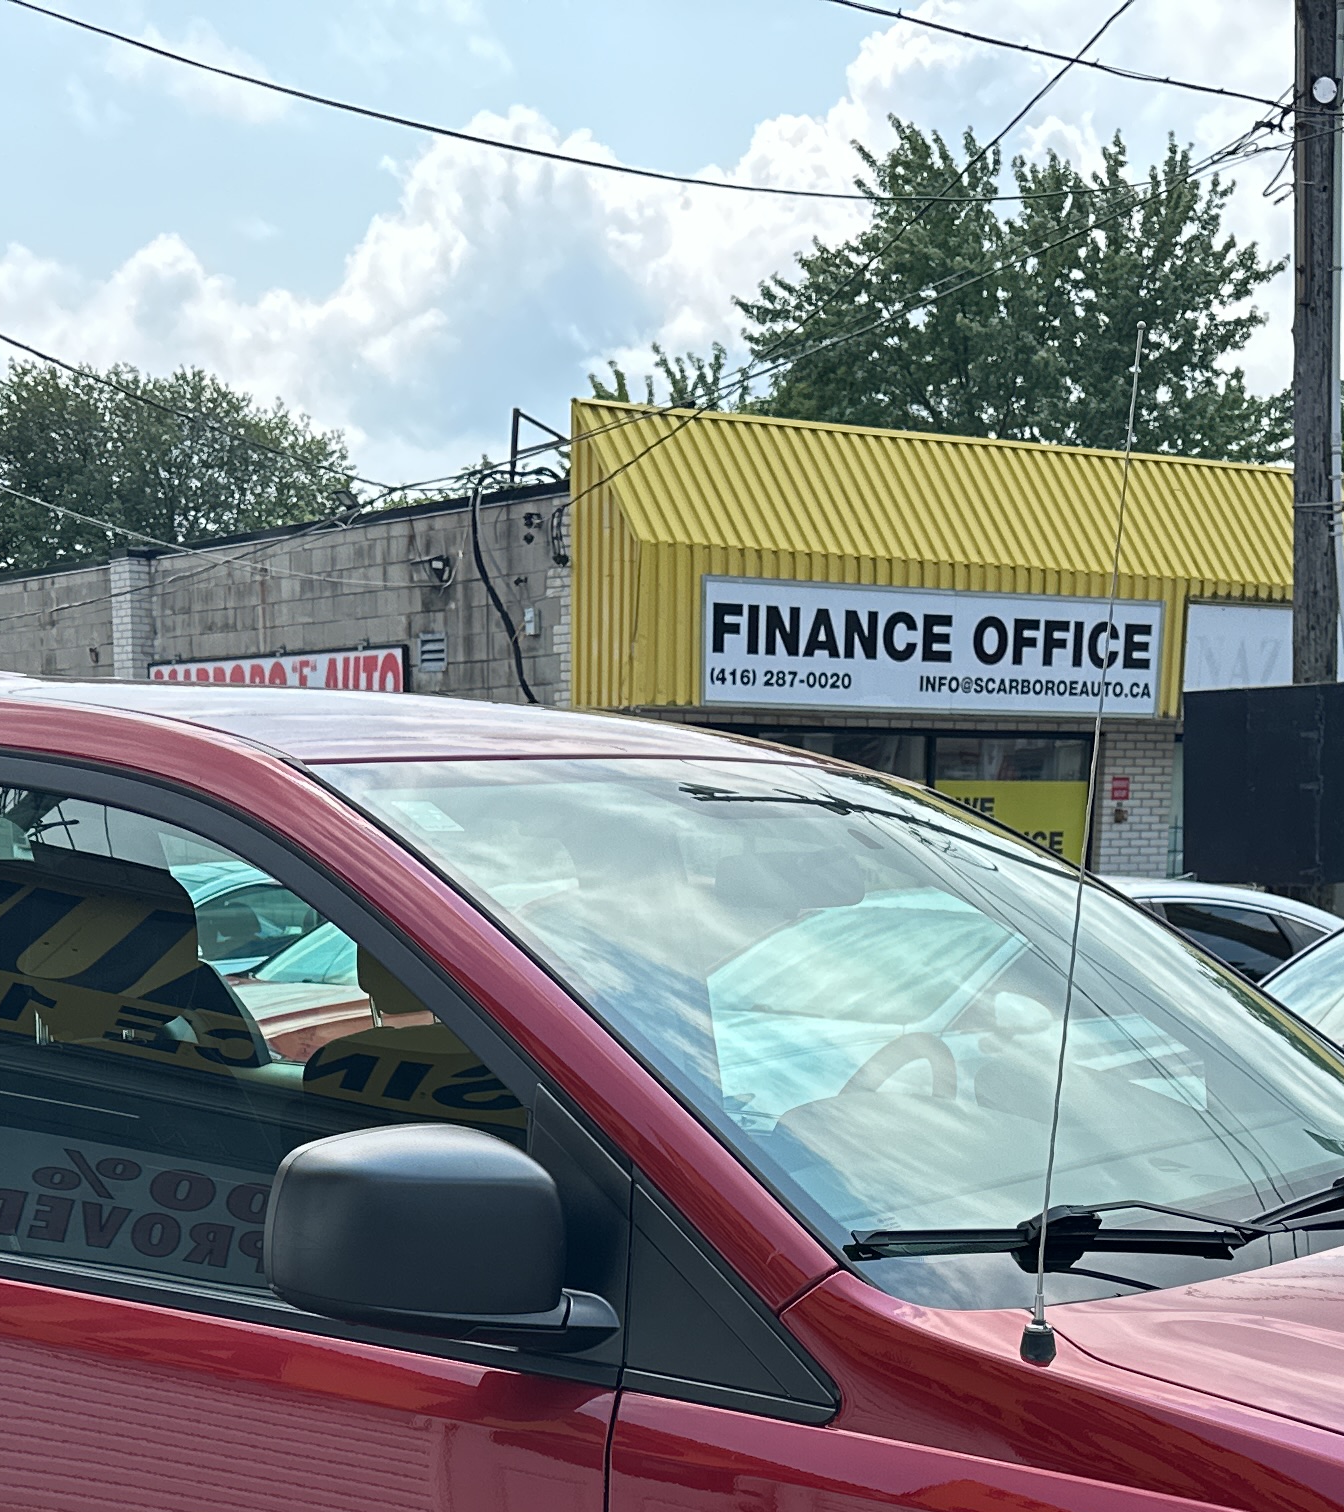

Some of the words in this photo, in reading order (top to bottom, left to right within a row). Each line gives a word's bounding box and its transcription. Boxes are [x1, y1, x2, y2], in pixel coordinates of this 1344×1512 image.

[712, 602, 953, 663] FINANCE
[973, 615, 1153, 670] OFFICE
[325, 652, 403, 692] AUTO
[709, 667, 757, 687] (416)
[763, 669, 852, 690] 287-0020
[918, 674, 1152, 699] INFO@SCARBOROEAUTO.CA
